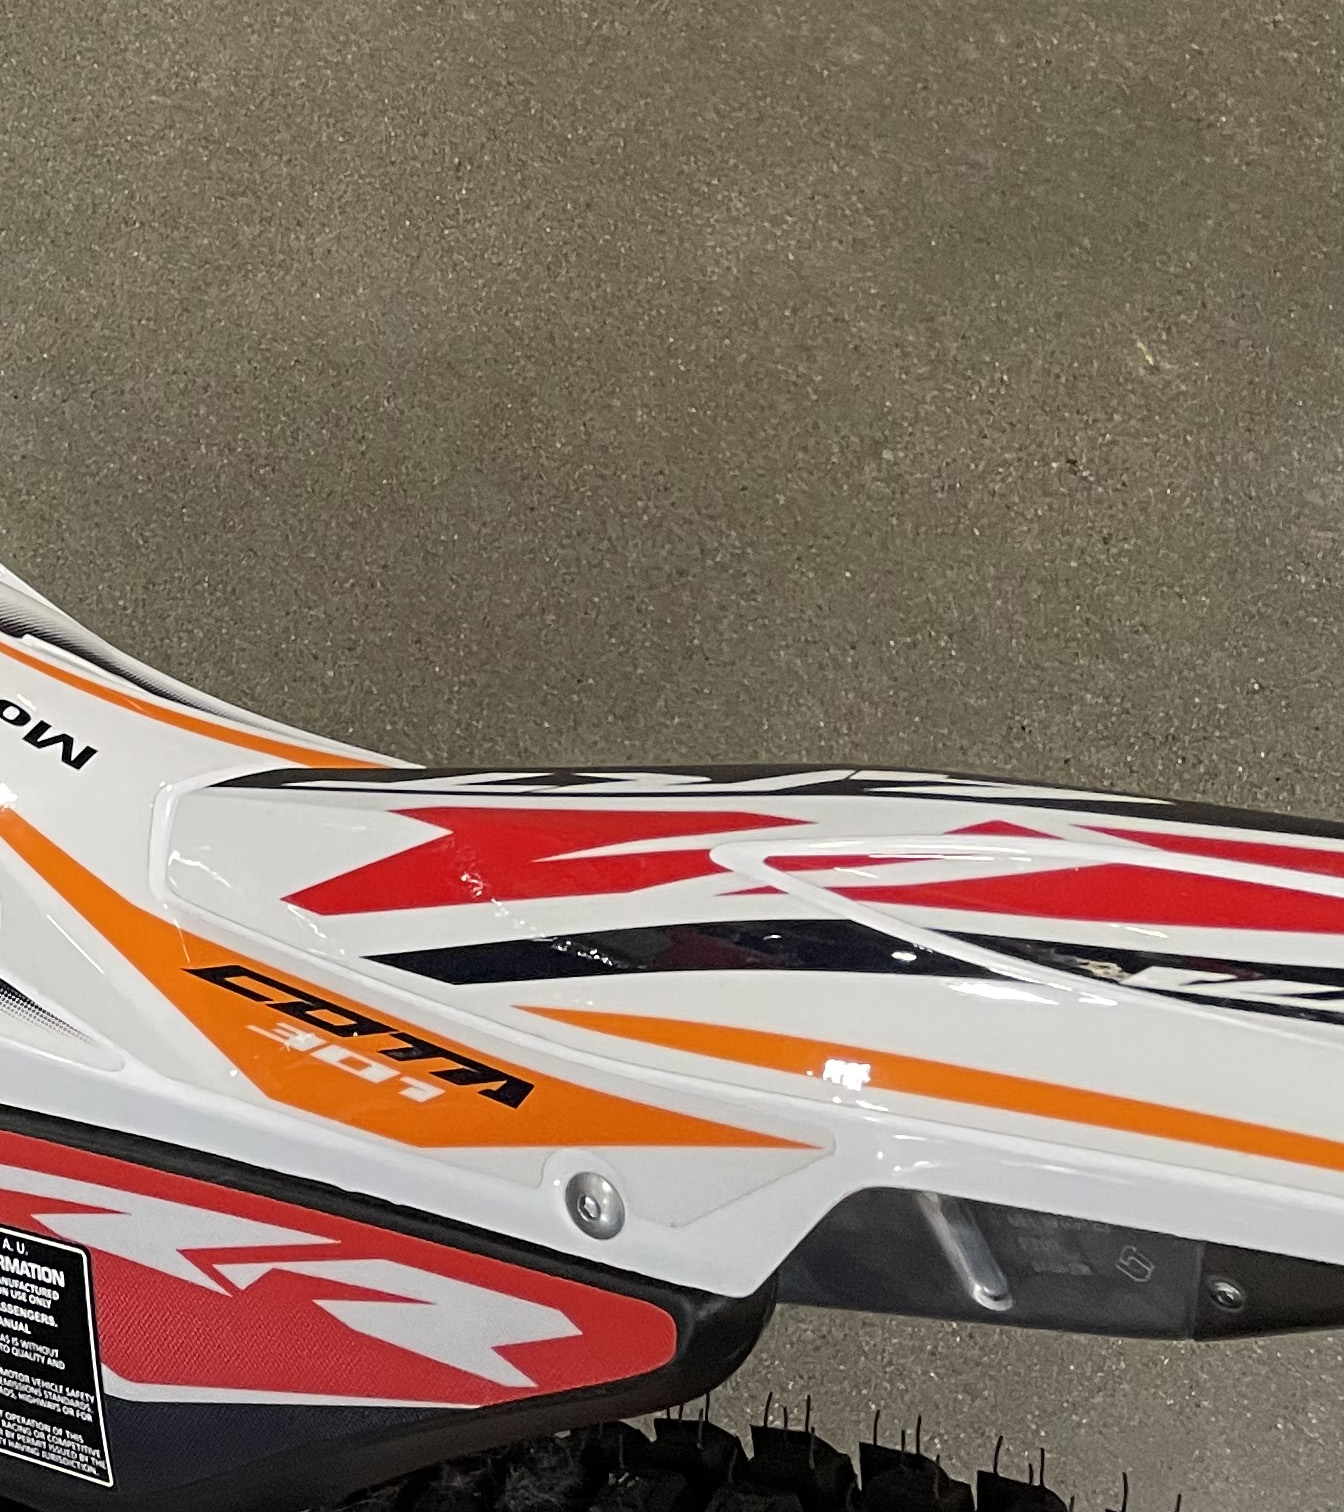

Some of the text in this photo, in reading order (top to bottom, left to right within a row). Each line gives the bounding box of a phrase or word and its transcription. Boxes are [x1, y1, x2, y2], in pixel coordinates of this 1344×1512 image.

[181, 965, 535, 1109] COTA
[1, 1236, 14, 1252] A.
[10, 1288, 27, 1302] USE
[28, 1293, 52, 1309] ONLY
[0, 1332, 10, 1344] AS
[19, 1338, 59, 1358] WITHOUT
[10, 1346, 45, 1364] QUALITY
[46, 1356, 65, 1370] AND
[0, 1366, 30, 1384] MOTOR
[61, 1404, 74, 1417] OR
[75, 1409, 93, 1422] FOR
